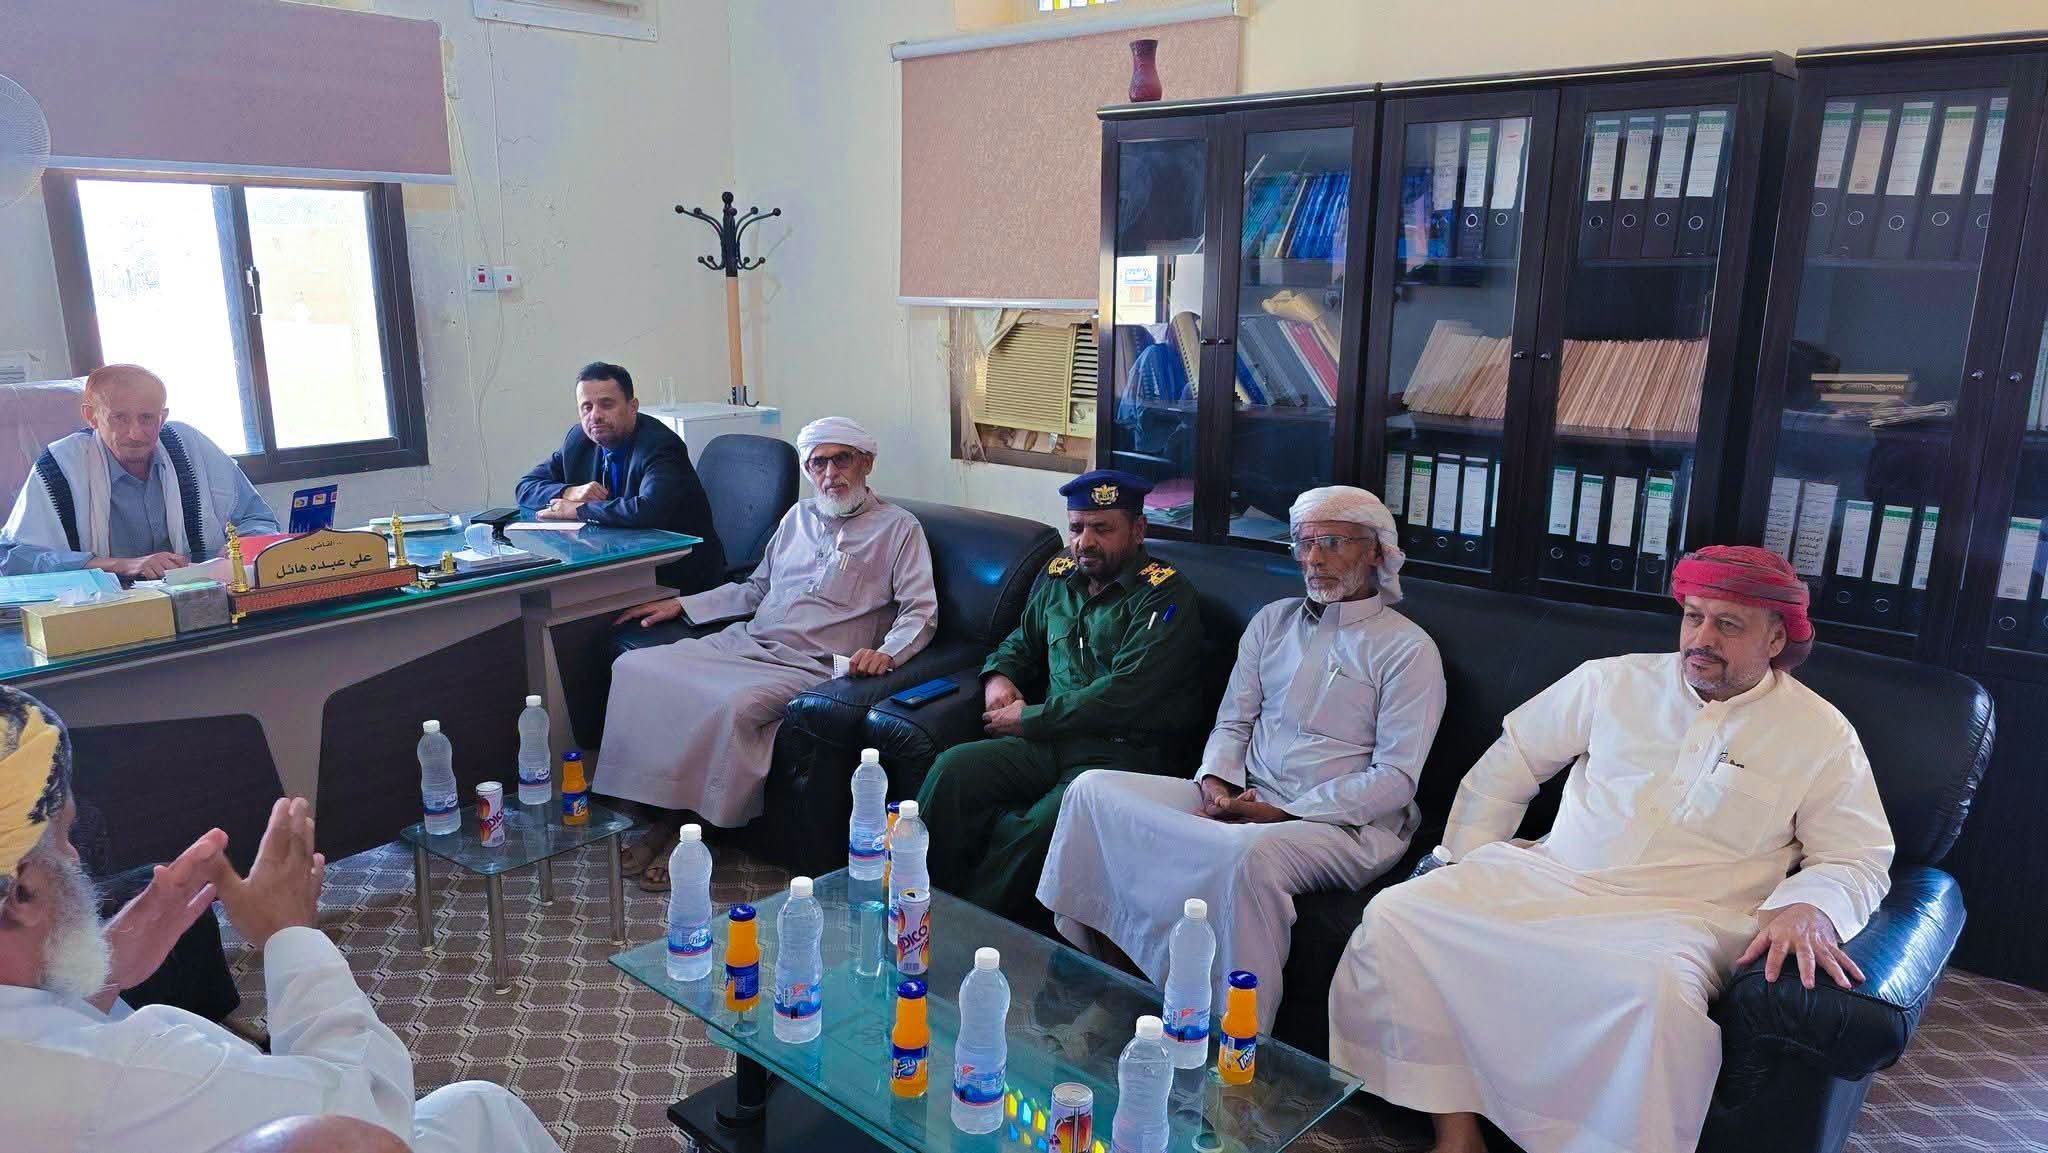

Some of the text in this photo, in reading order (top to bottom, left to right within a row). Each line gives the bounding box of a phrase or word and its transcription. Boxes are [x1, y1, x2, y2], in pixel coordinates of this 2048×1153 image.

[276, 552, 373, 579] علي عبده هائل
